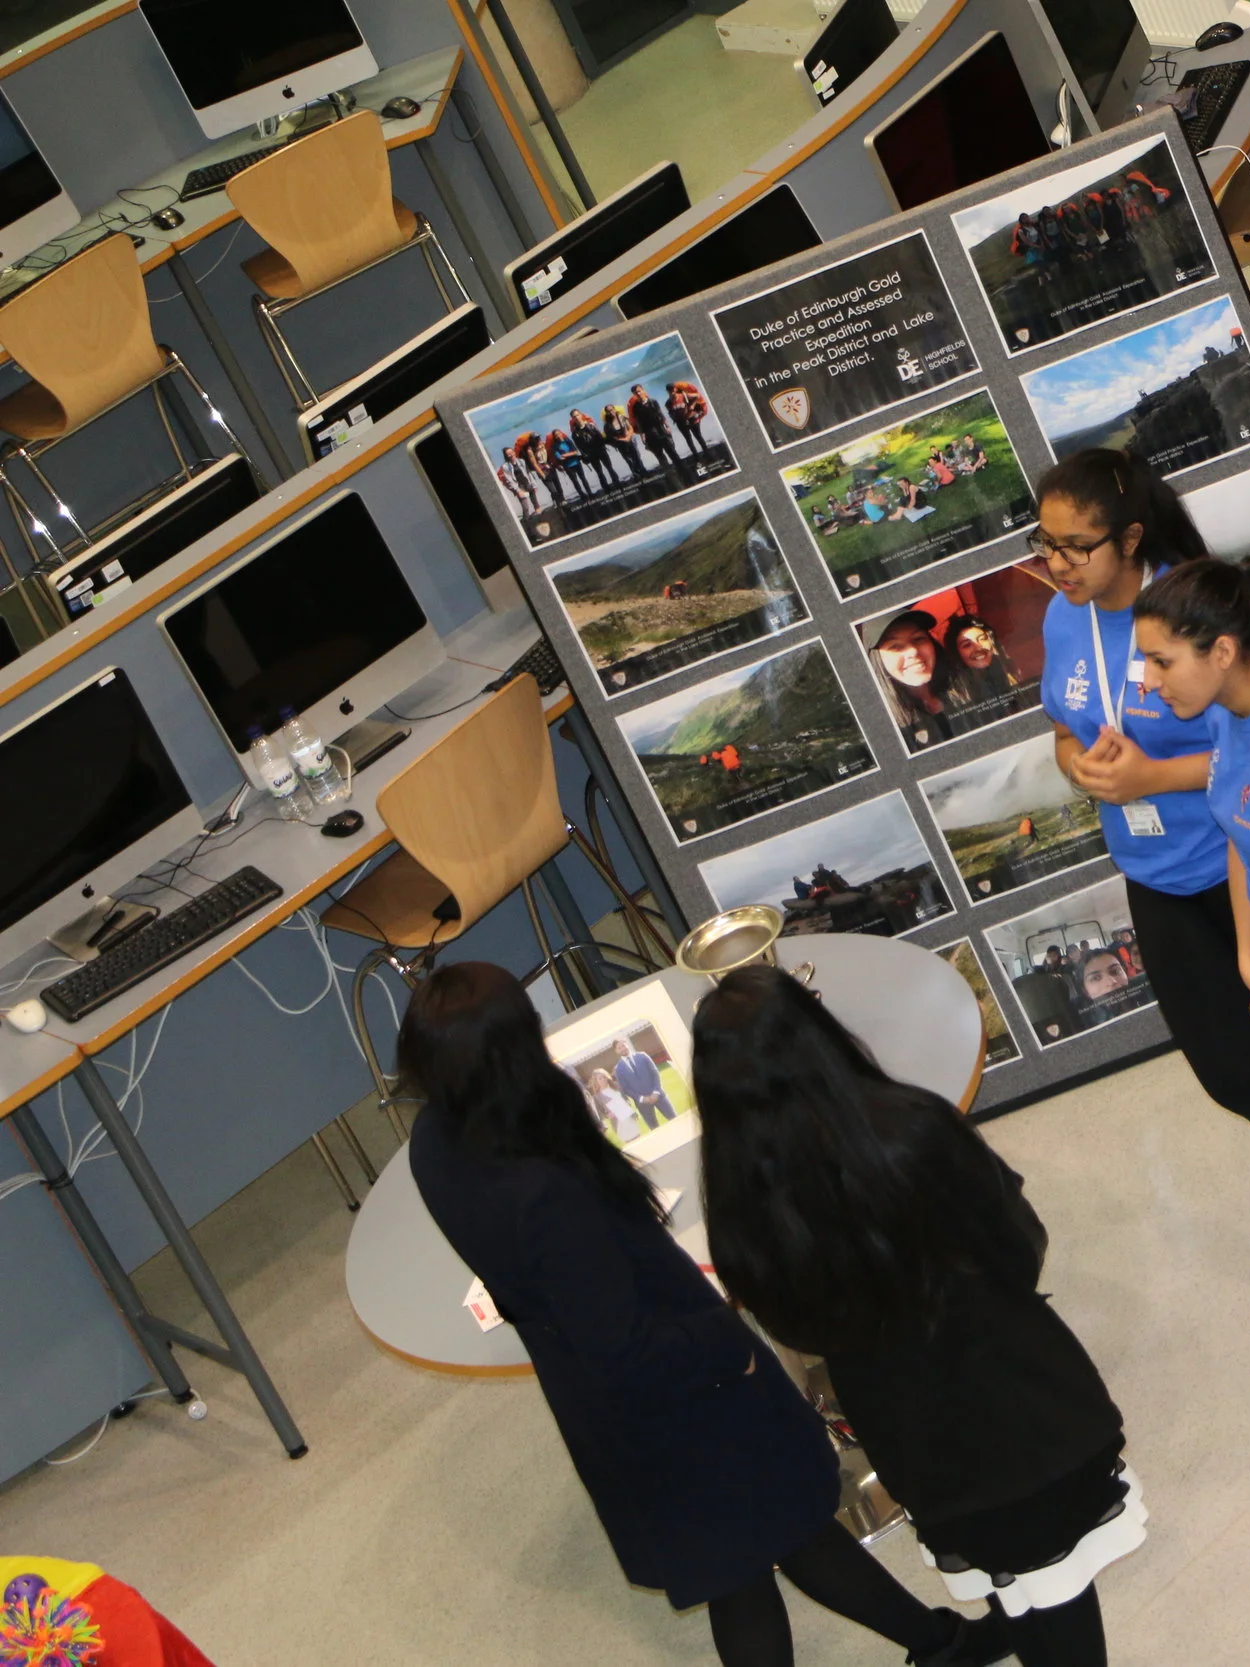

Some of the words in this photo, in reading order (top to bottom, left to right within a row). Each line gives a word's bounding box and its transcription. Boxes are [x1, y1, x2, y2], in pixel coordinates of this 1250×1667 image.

[750, 319, 784, 340] Duke
[786, 312, 800, 325] of
[802, 287, 867, 318] Edinburgh
[868, 272, 901, 293] Gold
[761, 323, 815, 352] Practice
[817, 312, 844, 330] and
[846, 289, 902, 318] Assessed
[755, 376, 767, 388] in
[769, 367, 791, 383] the
[792, 353, 825, 374] Peak
[827, 336, 870, 360] District
[871, 324, 898, 343] and
[903, 310, 934, 330] Lake
[805, 318, 872, 353] Expedition
[924, 340, 966, 362] HIGHFIELDS
[828, 351, 874, 376] District.
[928, 353, 959, 371] SCHOOL
